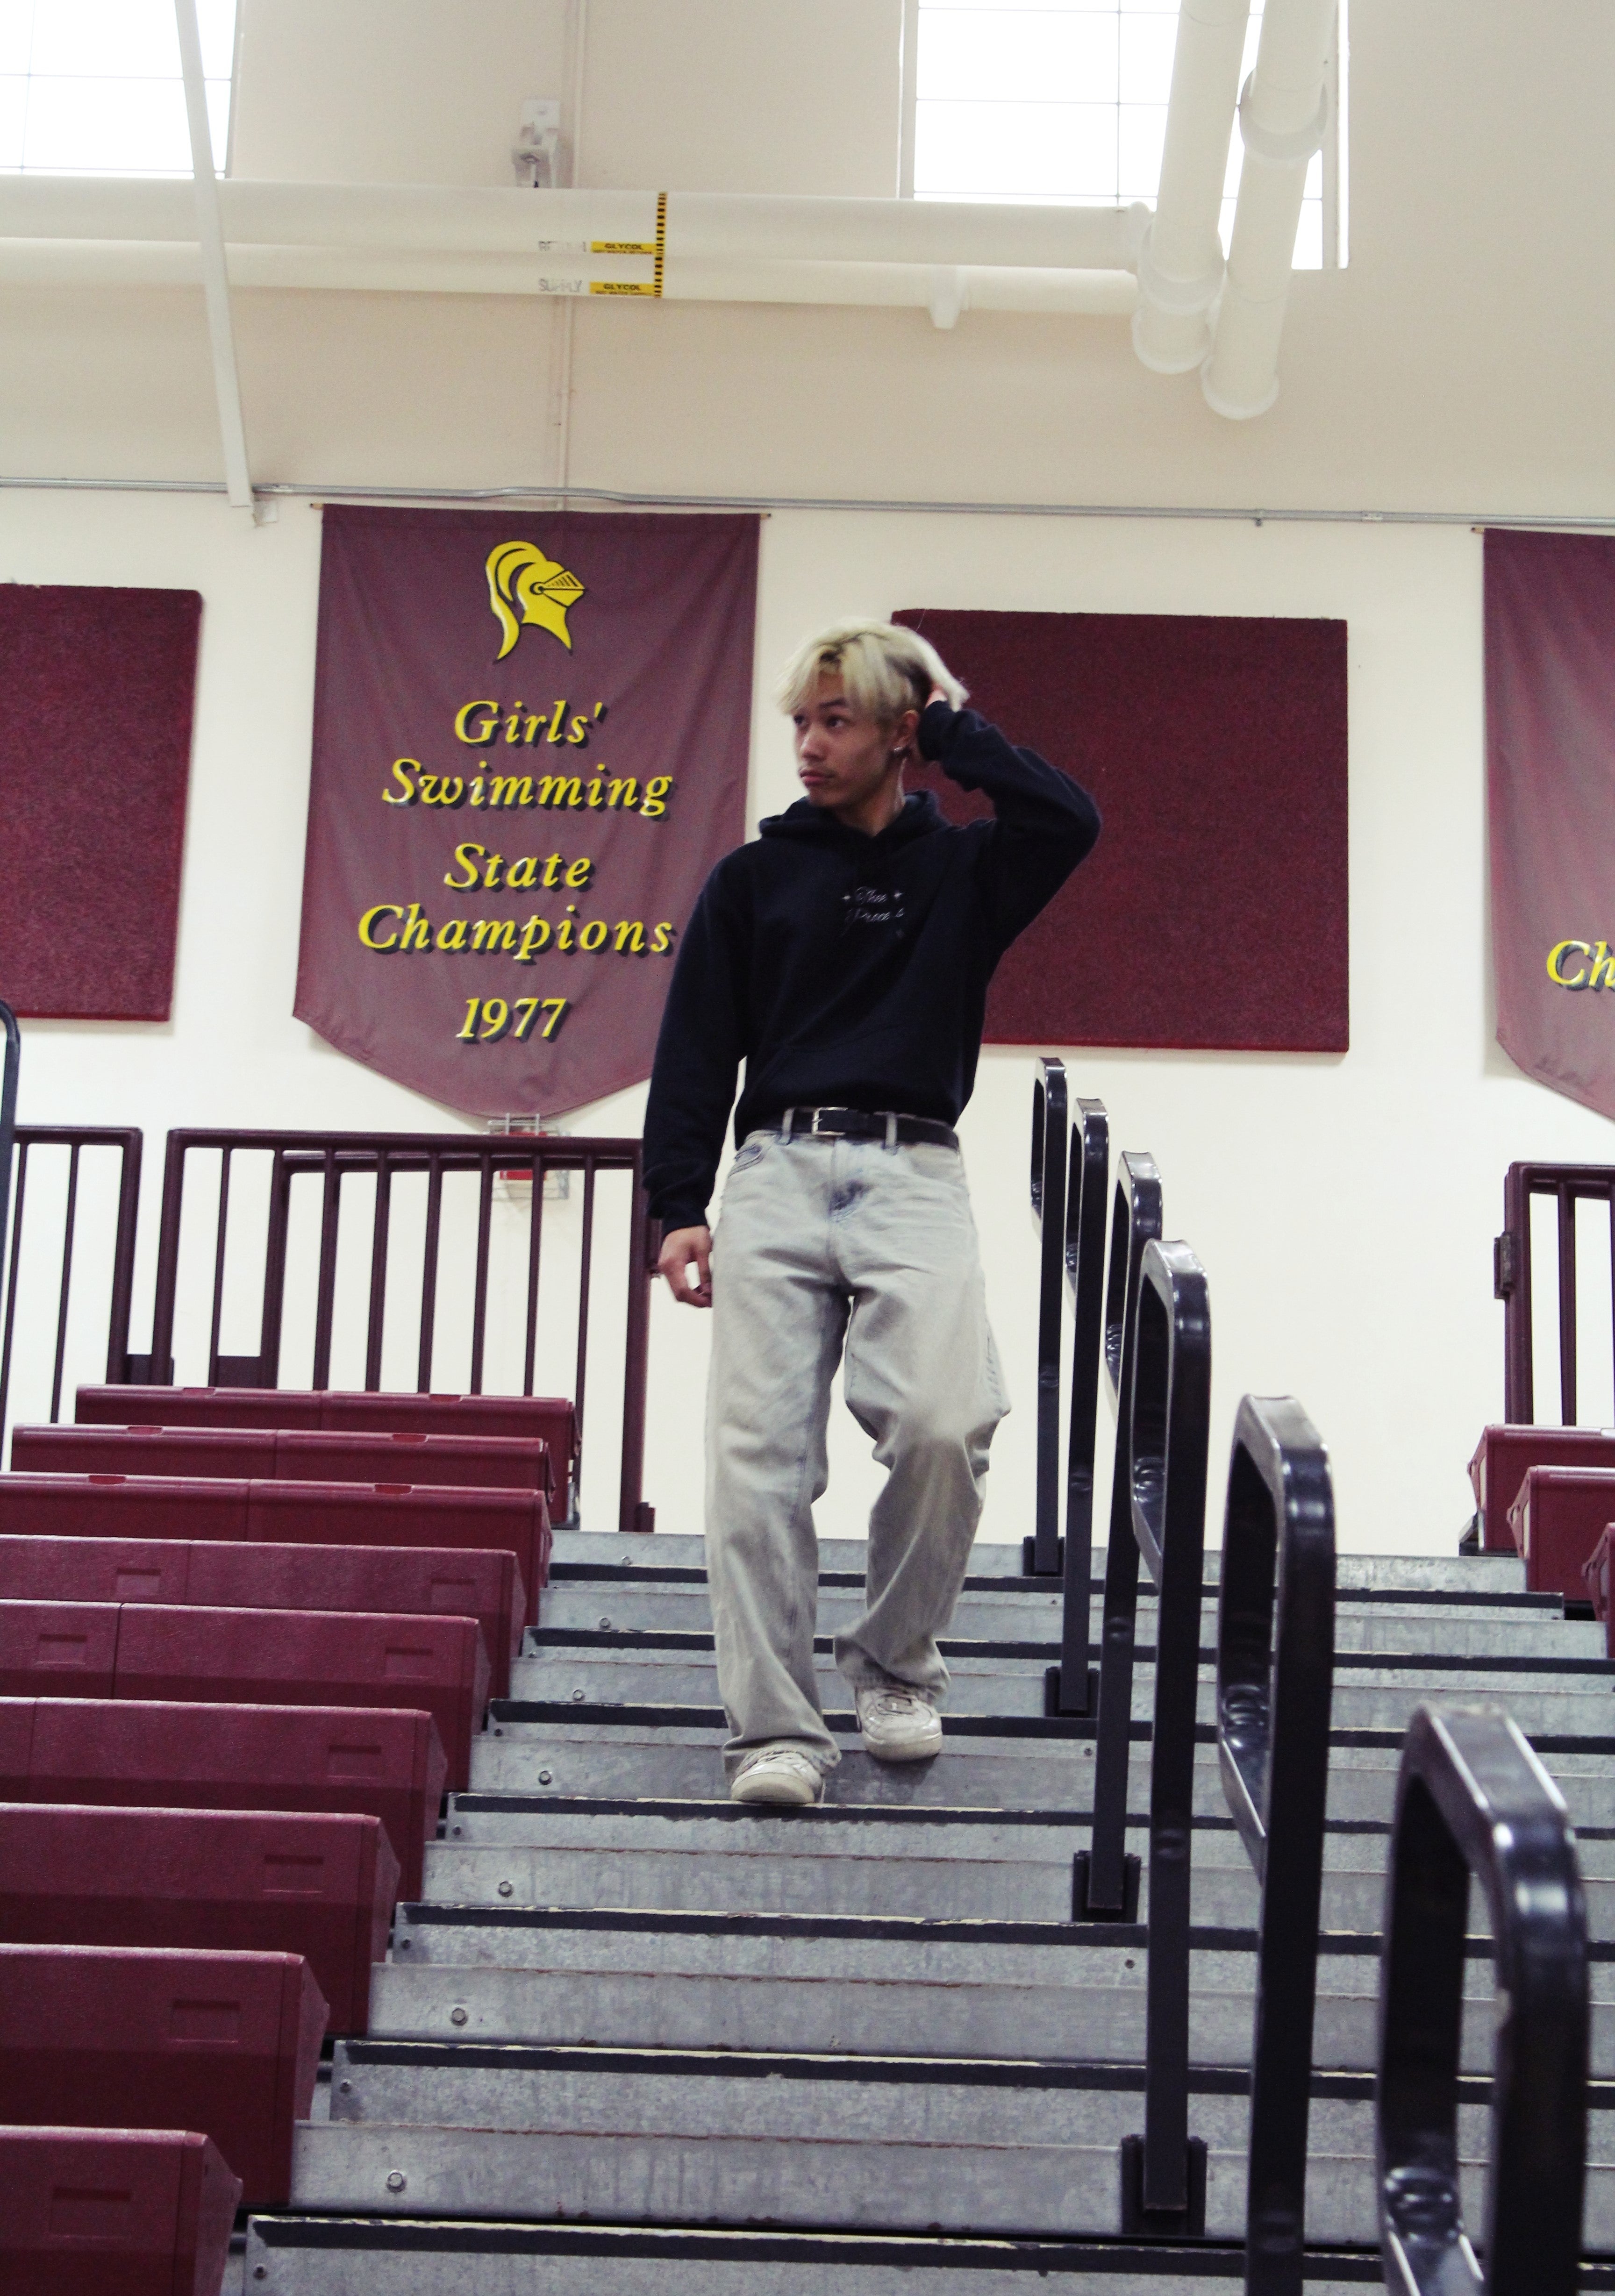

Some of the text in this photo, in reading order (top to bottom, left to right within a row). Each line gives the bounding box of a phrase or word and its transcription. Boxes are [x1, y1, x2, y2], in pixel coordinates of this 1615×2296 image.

[454, 699, 603, 744] Girls'
[381, 758, 673, 817] Swimming
[444, 842, 592, 888] State
[358, 903, 673, 961] Champions
[455, 998, 567, 1038] 1977
